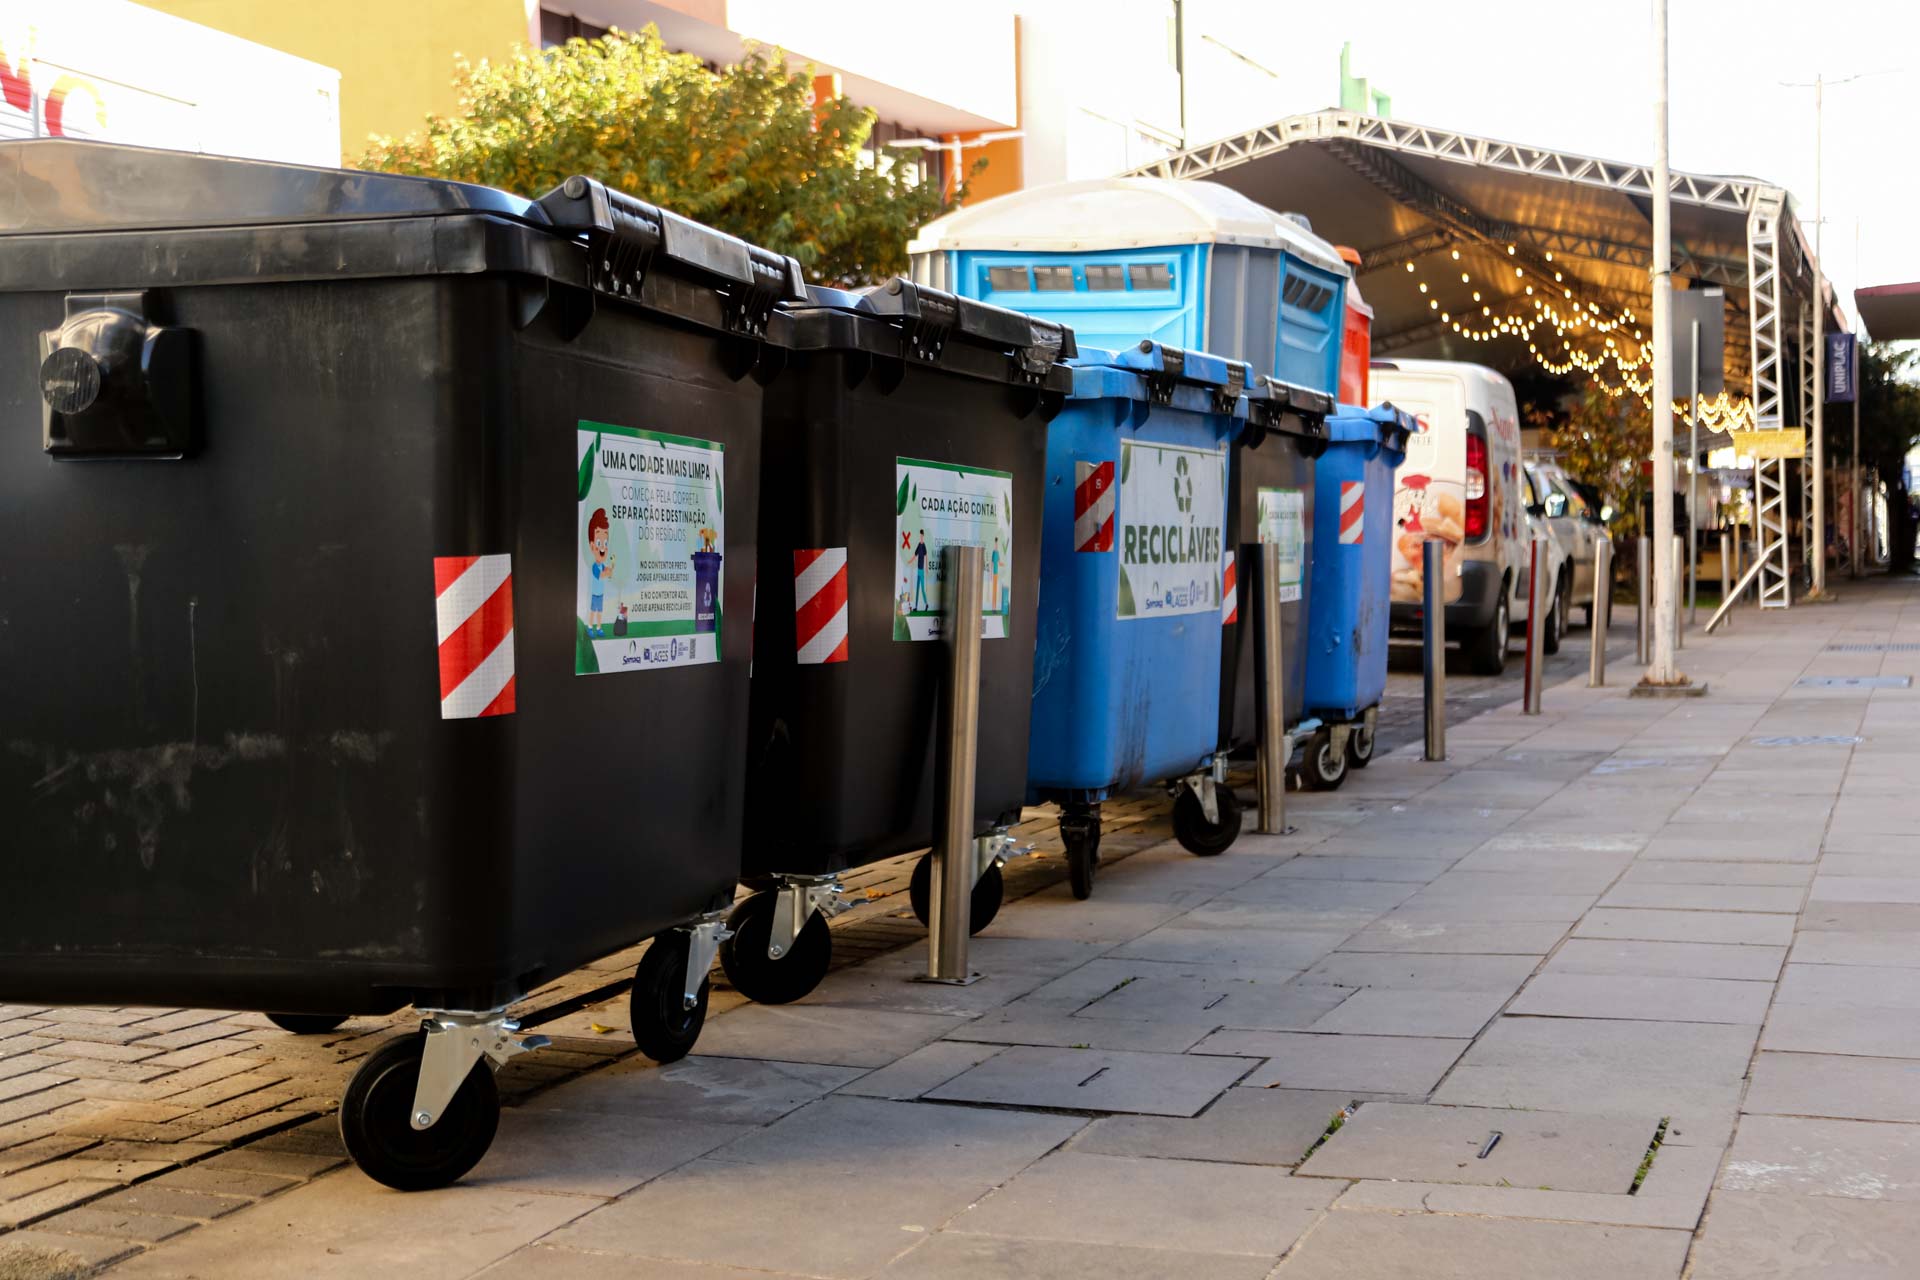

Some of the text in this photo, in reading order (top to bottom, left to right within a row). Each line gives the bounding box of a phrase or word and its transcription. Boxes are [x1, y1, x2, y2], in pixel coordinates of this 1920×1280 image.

[1834, 340, 1846, 393] UNIPLAC
[602, 449, 711, 480] UMA CIDADE MAIS LIMPA
[656, 489, 671, 503] PELA
[921, 496, 997, 518] CADA AÇÃO CONTA!
[612, 504, 706, 528] SEPARAÇÃO E DESTINAÇÃO
[638, 526, 654, 541] DOS
[1124, 514, 1220, 565] RECICLÁVEIS
[650, 649, 669, 663] LAGES
